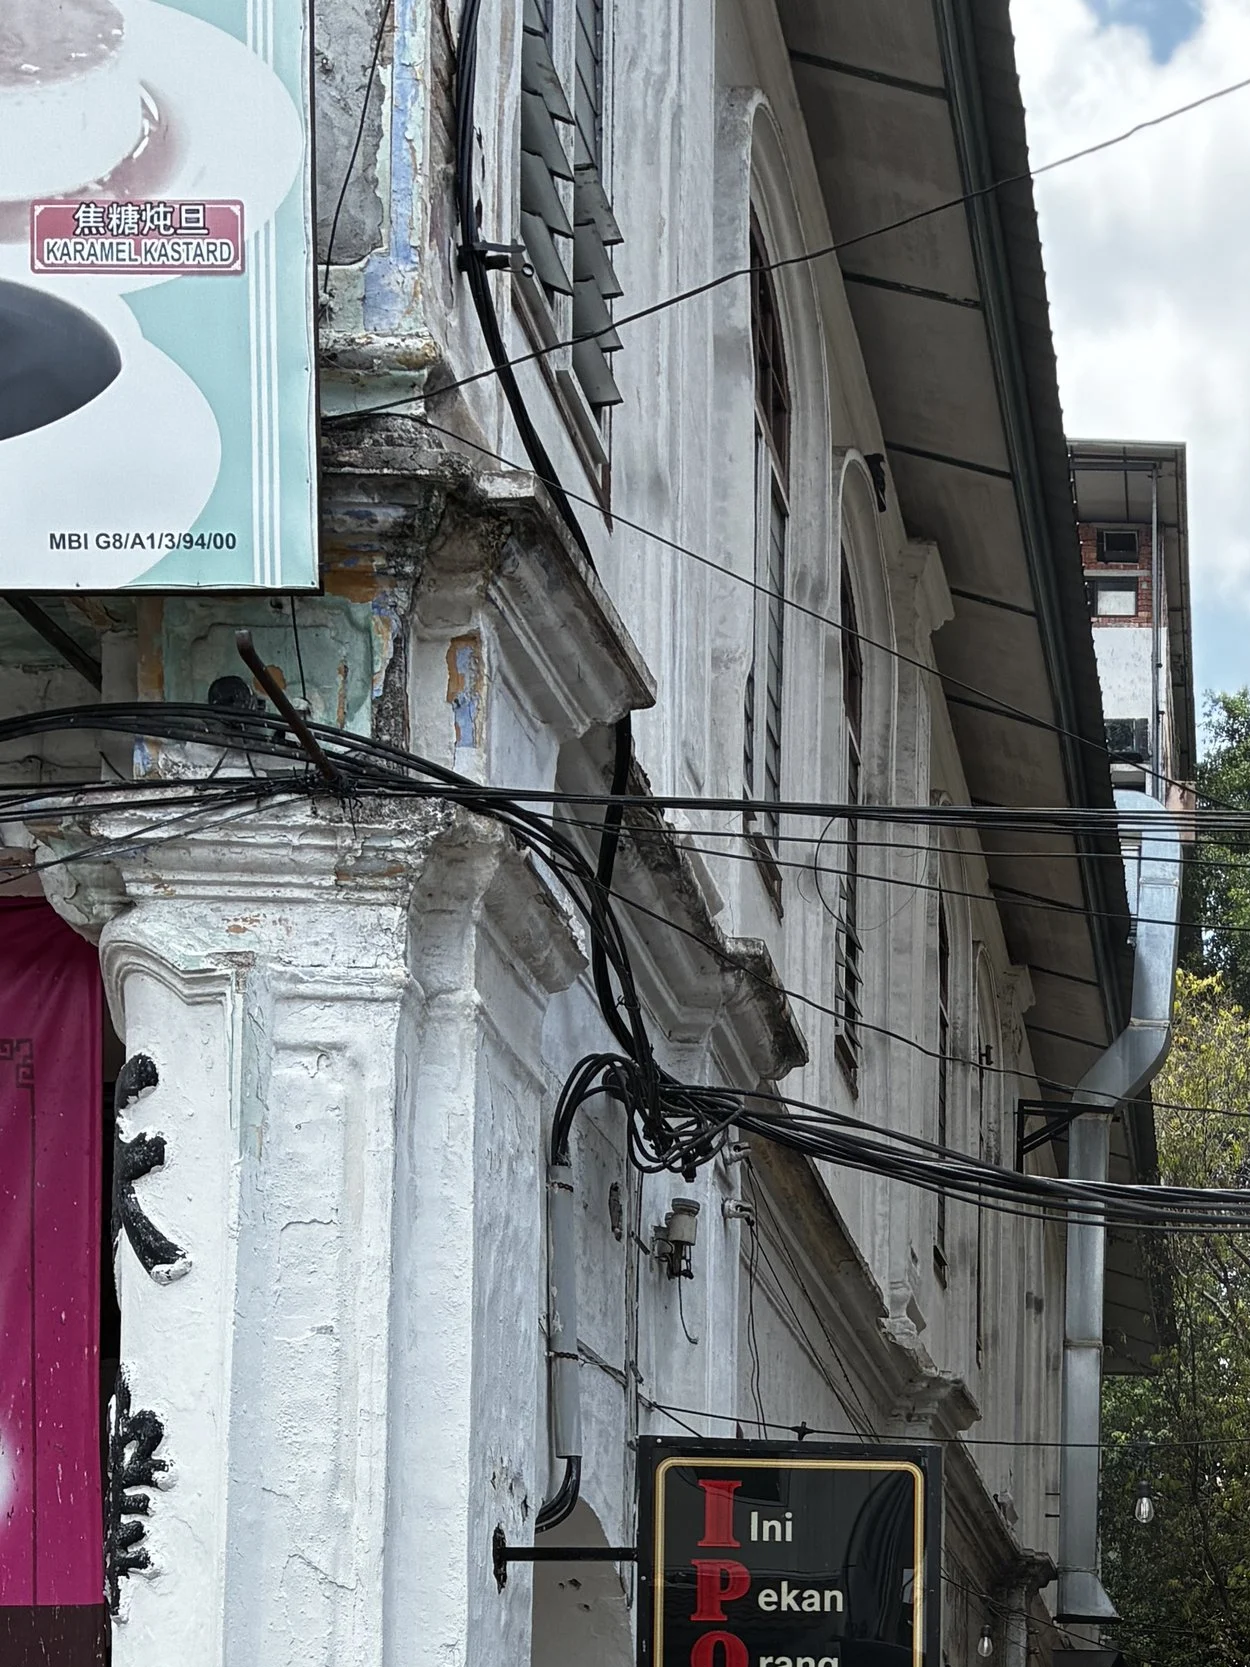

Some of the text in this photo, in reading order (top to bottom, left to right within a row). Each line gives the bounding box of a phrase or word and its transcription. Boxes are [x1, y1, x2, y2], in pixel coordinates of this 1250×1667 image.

[73, 201, 209, 236] 焦糖炖旦
[45, 241, 233, 263] KARAMEL KASTARD
[49, 532, 237, 550] MBI G8/A1/3/94/00
[750, 1512, 793, 1542] Ini
